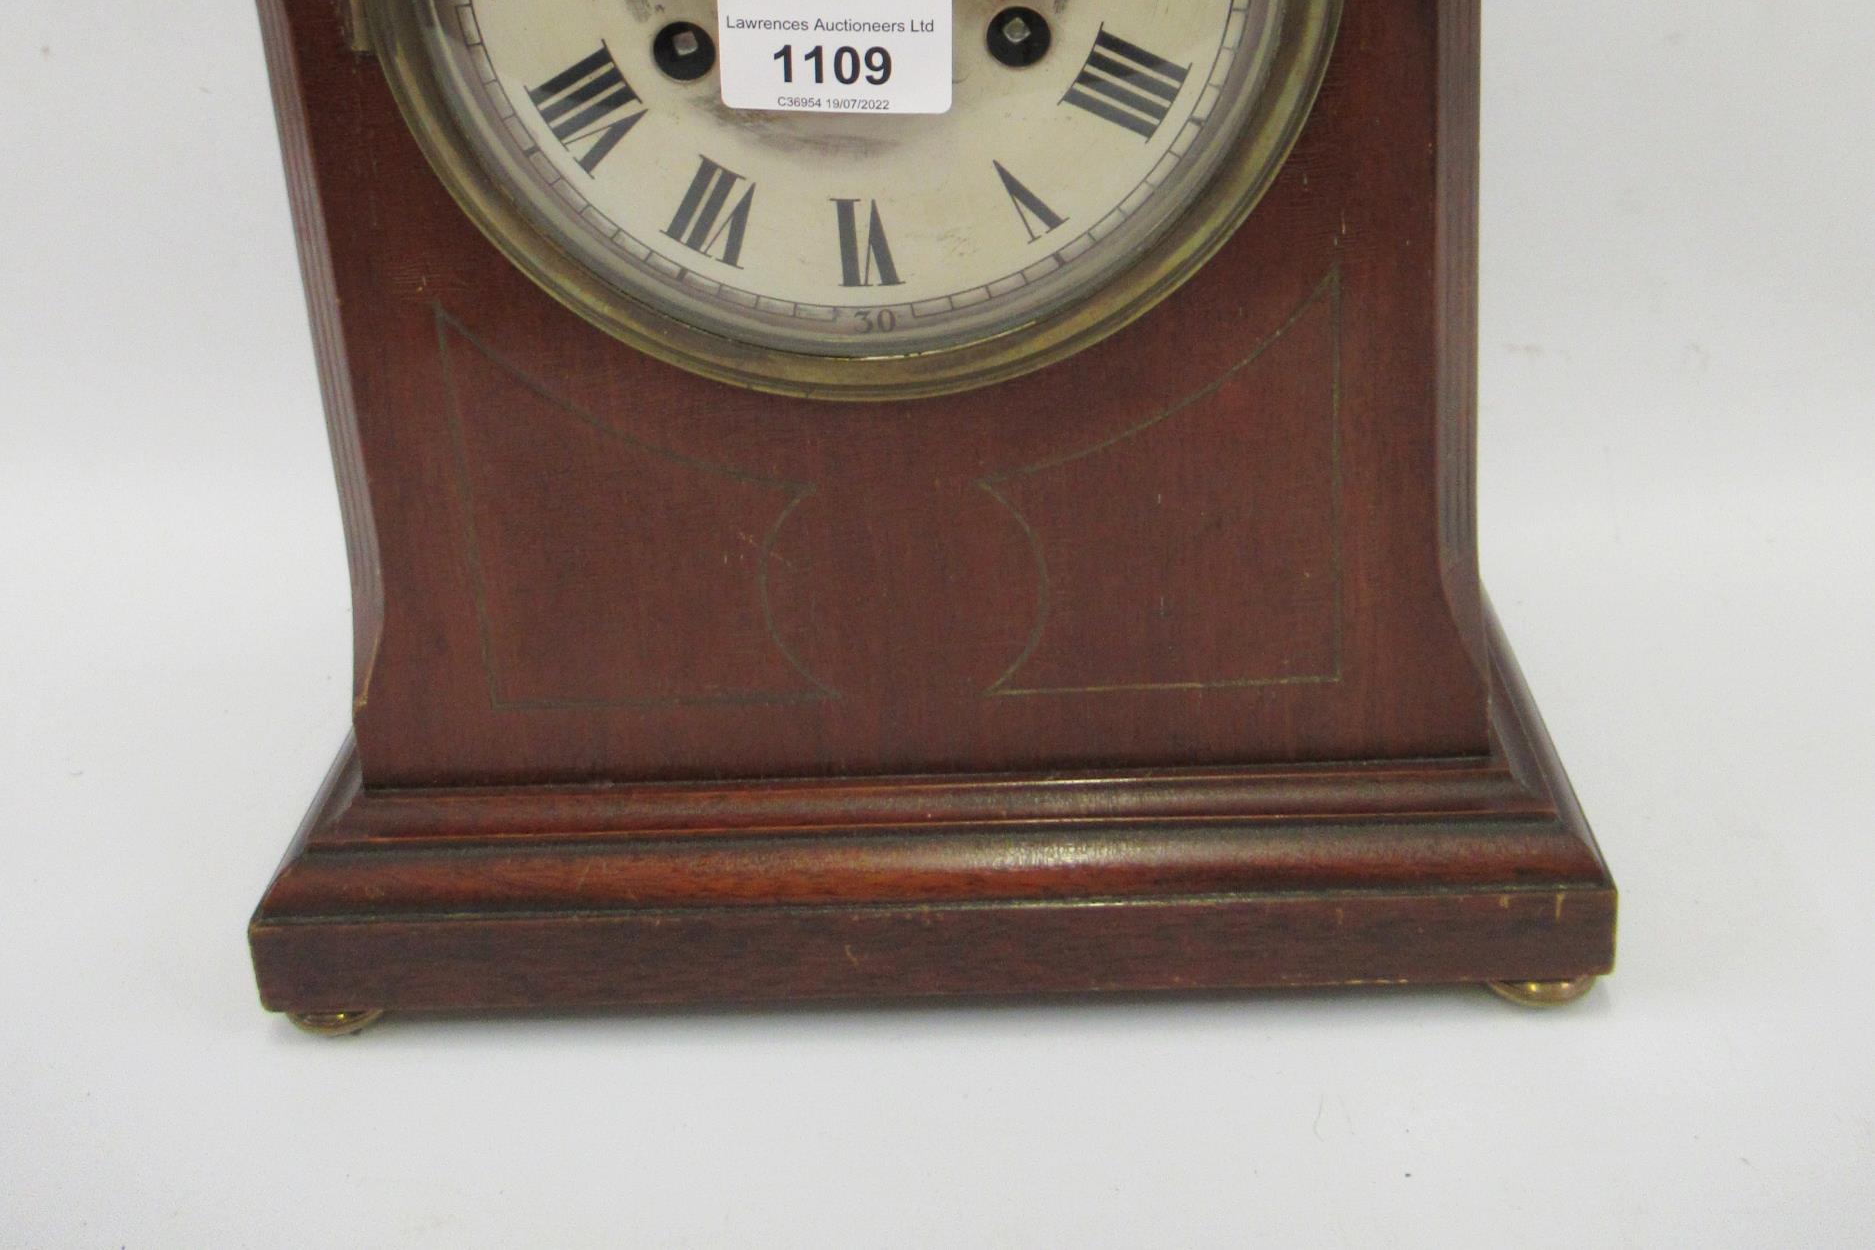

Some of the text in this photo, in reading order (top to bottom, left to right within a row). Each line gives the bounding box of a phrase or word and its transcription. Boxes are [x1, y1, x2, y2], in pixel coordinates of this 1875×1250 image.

[726, 15, 935, 32] Lawrences Auctioneers Ltd
[773, 44, 892, 85] 1109
[524, 39, 649, 179] VIII
[777, 96, 890, 110] C36954 19/07/2022
[1057, 22, 1192, 144] IIII
[660, 154, 757, 270] VII
[829, 197, 906, 287] VI
[992, 159, 1069, 244] V
[854, 308, 898, 334] 30
